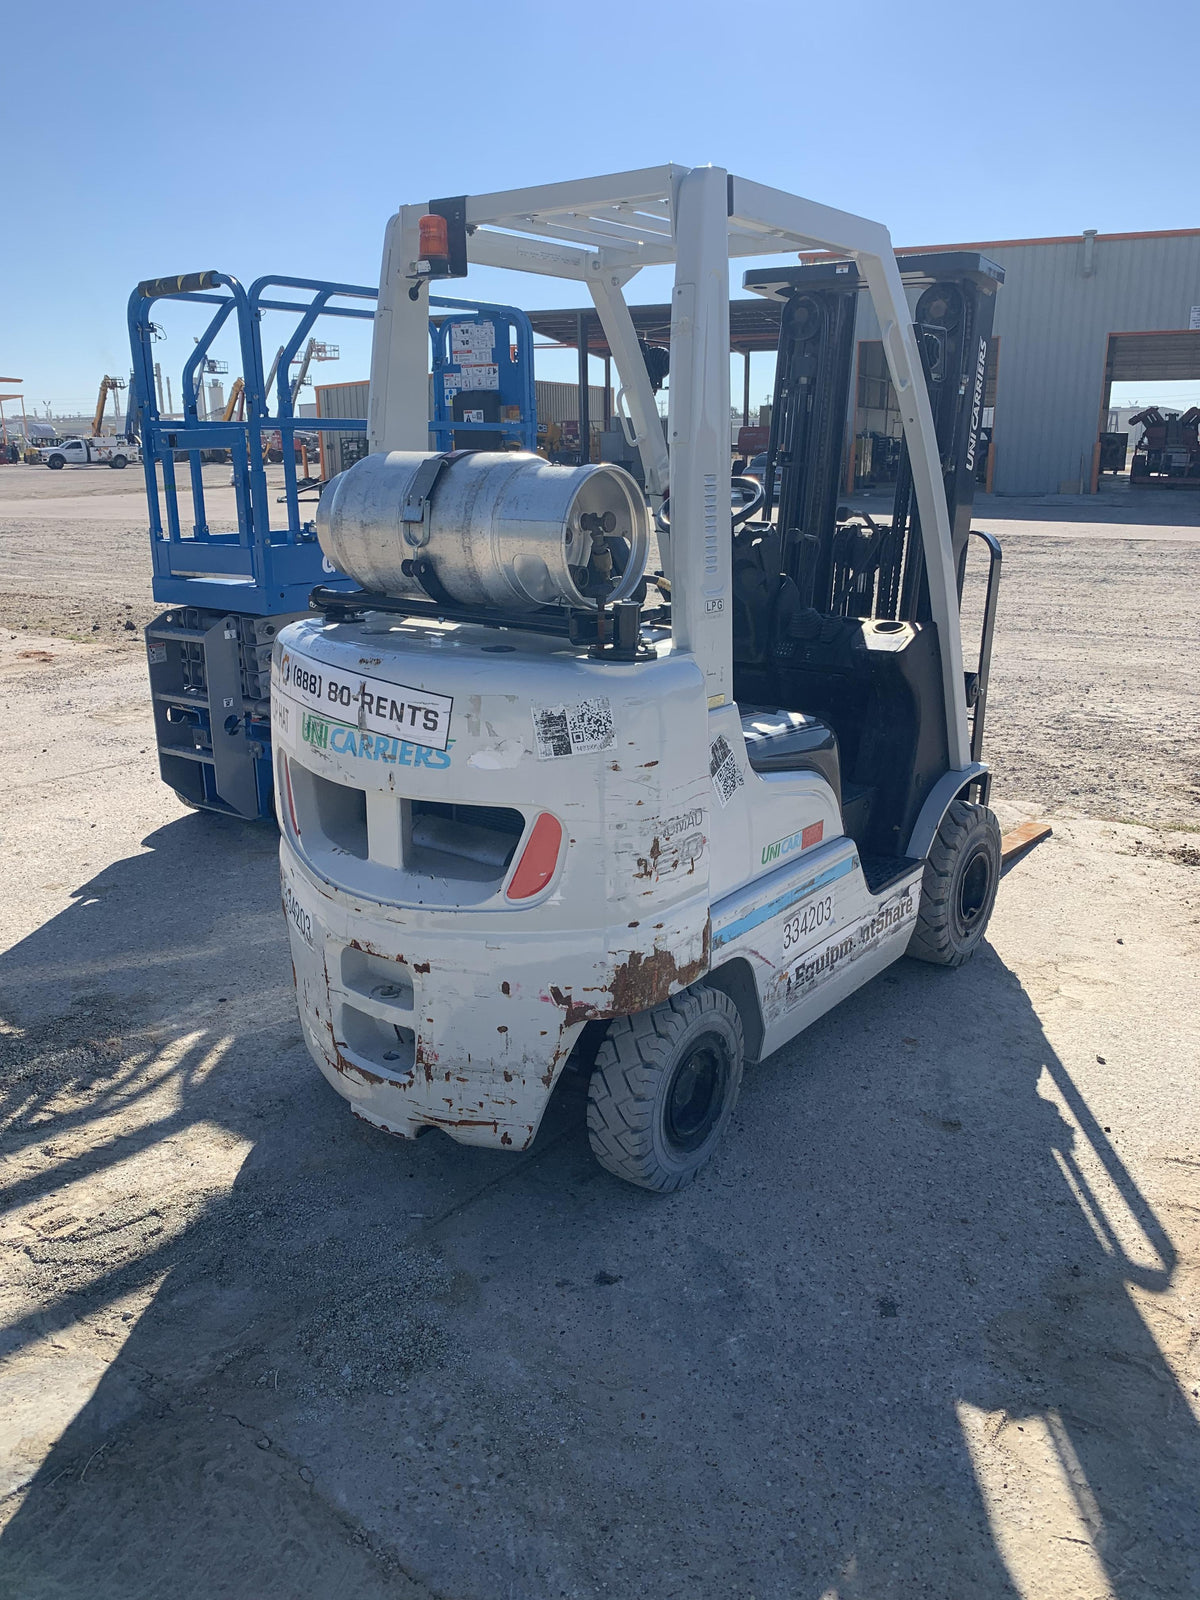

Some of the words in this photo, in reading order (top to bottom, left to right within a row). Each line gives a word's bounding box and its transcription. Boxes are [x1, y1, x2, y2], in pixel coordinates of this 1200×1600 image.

[537, 423, 548, 433] CB
[965, 336, 987, 471] UNICARRIERS
[706, 600, 723, 612] LPG
[293, 664, 323, 698] (888)
[328, 681, 439, 732] 80-RENTS
[302, 711, 455, 770] UNICARRIERS
[761, 829, 803, 865] UNICAR
[783, 896, 832, 950] 334203
[794, 896, 914, 990] EquipmntShare
